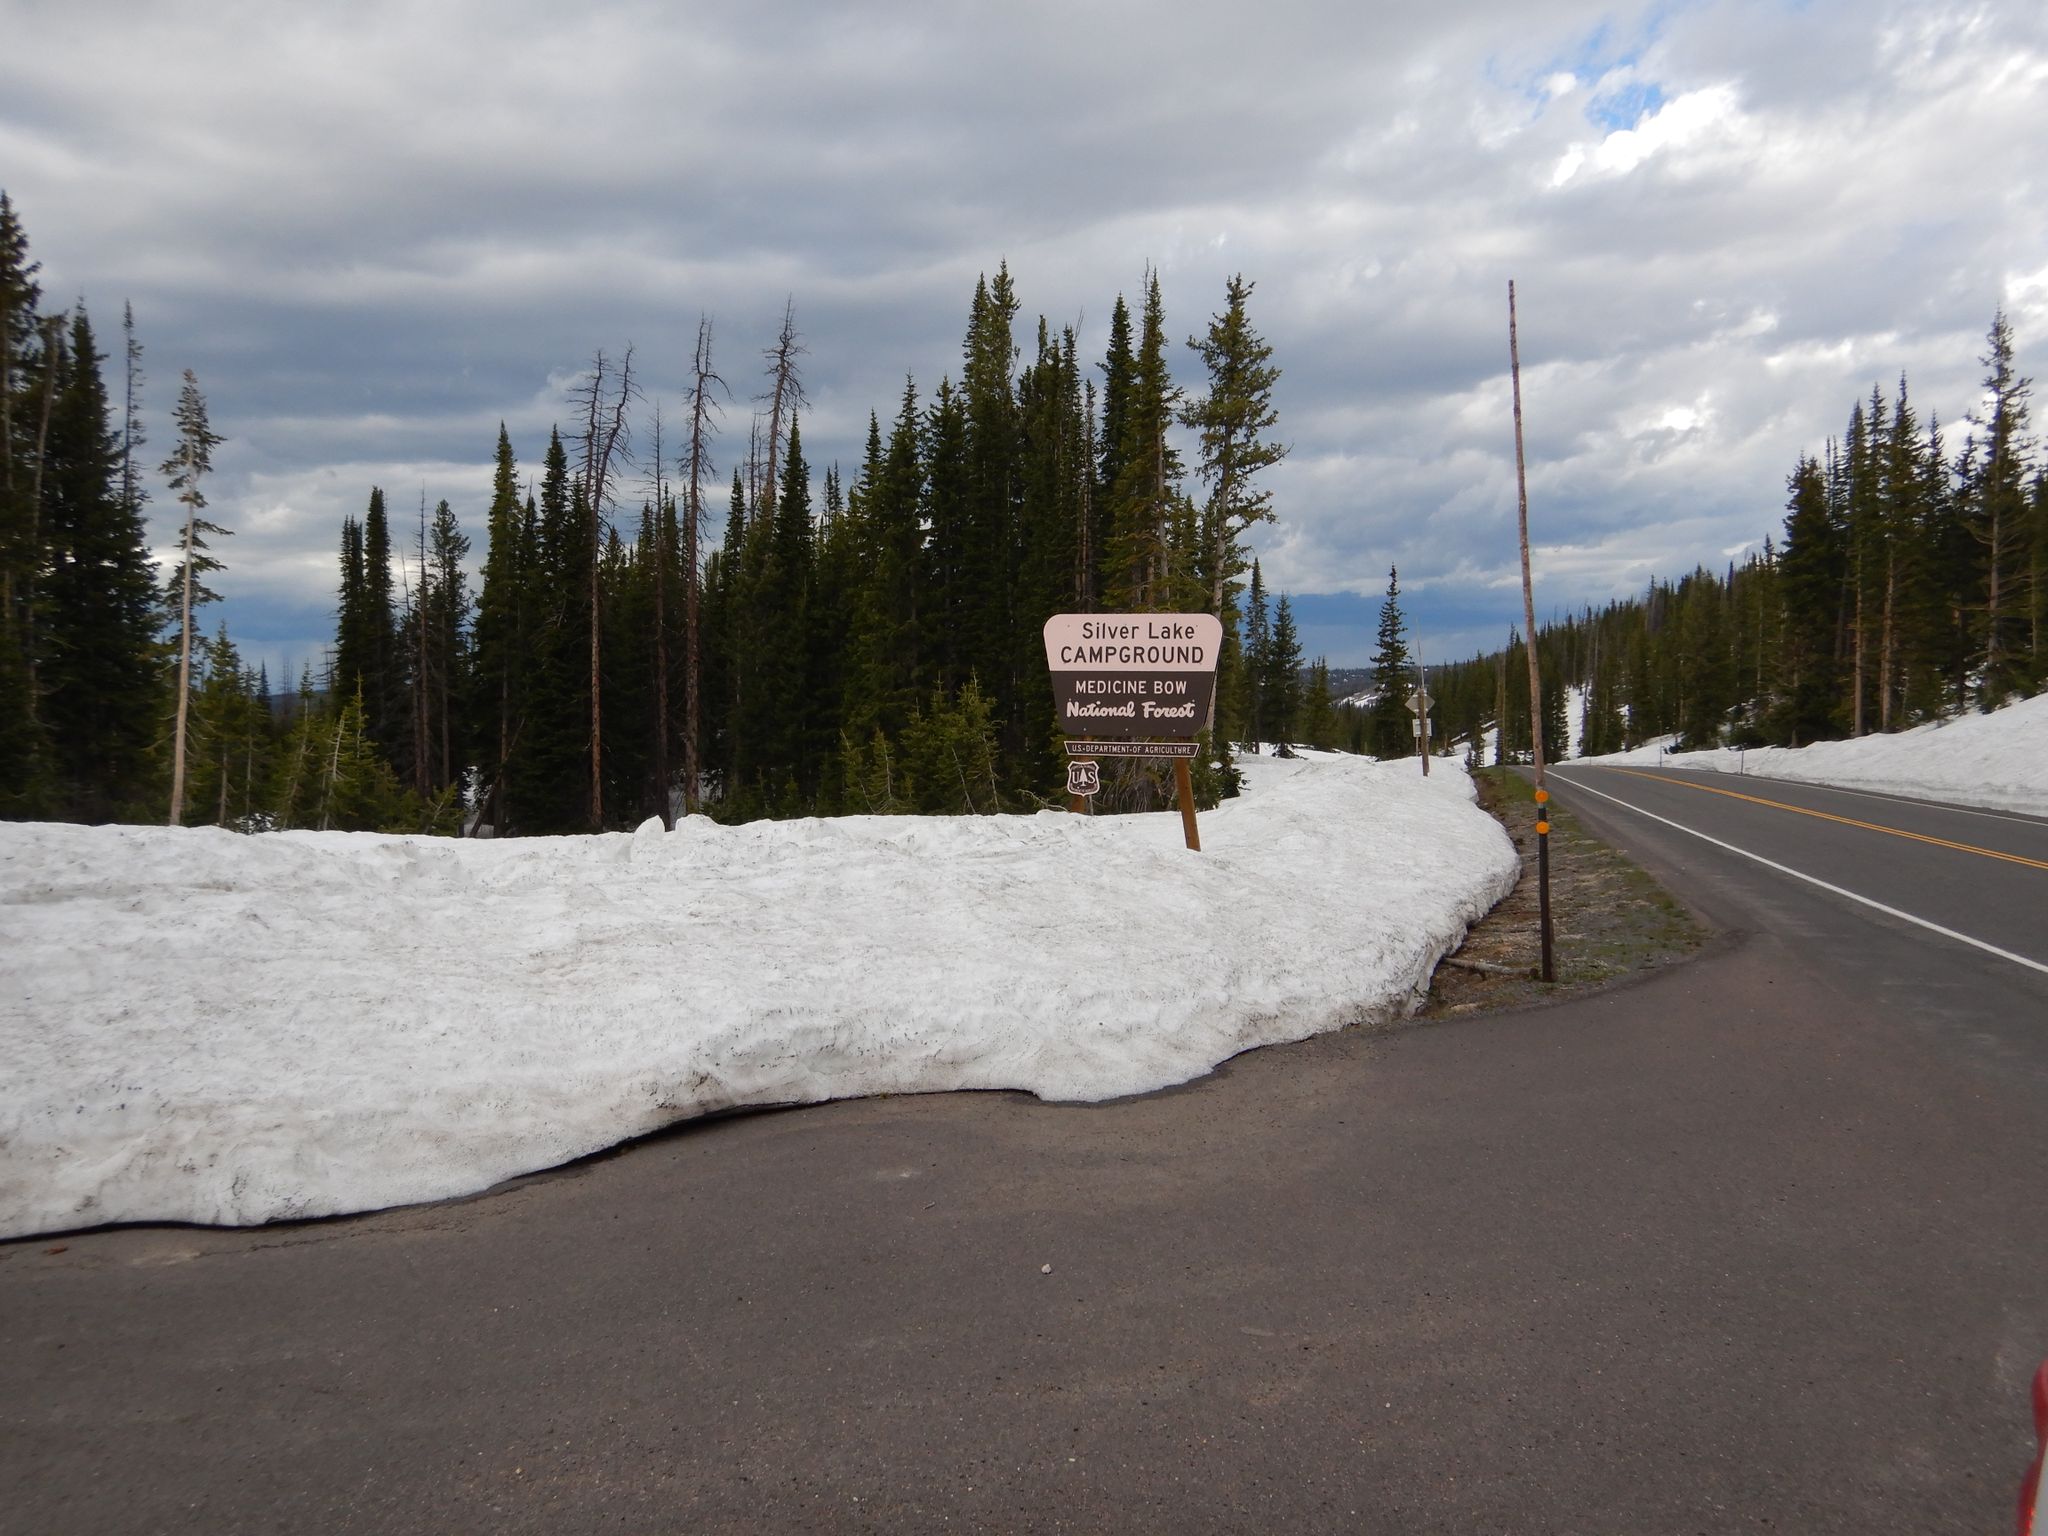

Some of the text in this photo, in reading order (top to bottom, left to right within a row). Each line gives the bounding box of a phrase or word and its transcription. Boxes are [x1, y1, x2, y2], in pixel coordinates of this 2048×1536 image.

[1082, 622, 1195, 639] Silver Lake
[1060, 646, 1204, 664] CAMPGROUND
[1075, 680, 1187, 695] MEDICINE BOW
[1066, 701, 1196, 719] National Forest
[1086, 745, 1129, 754] DEPARTMENT
[1132, 746, 1141, 754] OF
[1144, 746, 1191, 755] AGRICULTURE
